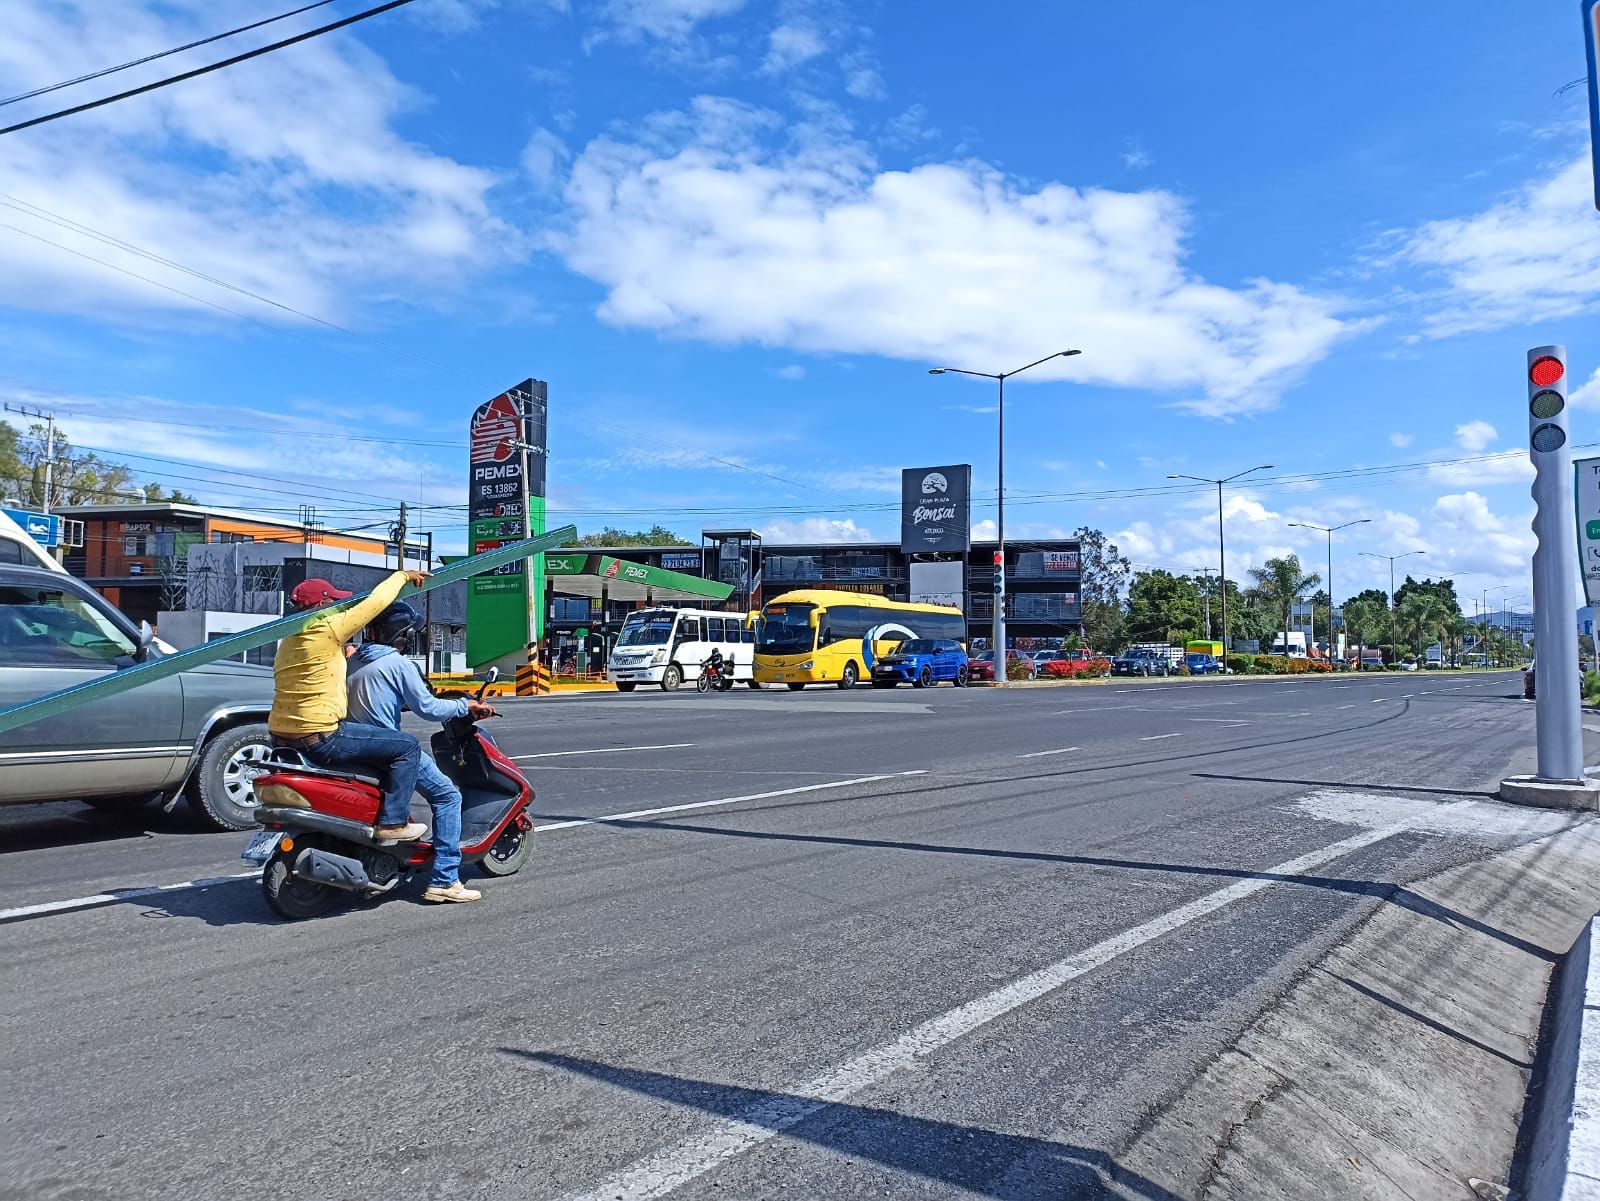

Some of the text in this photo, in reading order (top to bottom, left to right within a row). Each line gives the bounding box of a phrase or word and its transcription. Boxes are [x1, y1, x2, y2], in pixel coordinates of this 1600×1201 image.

[481, 482, 518, 495] ES 13862
[912, 503, 956, 525] Bonsai
[624, 566, 649, 579] PEMEX
